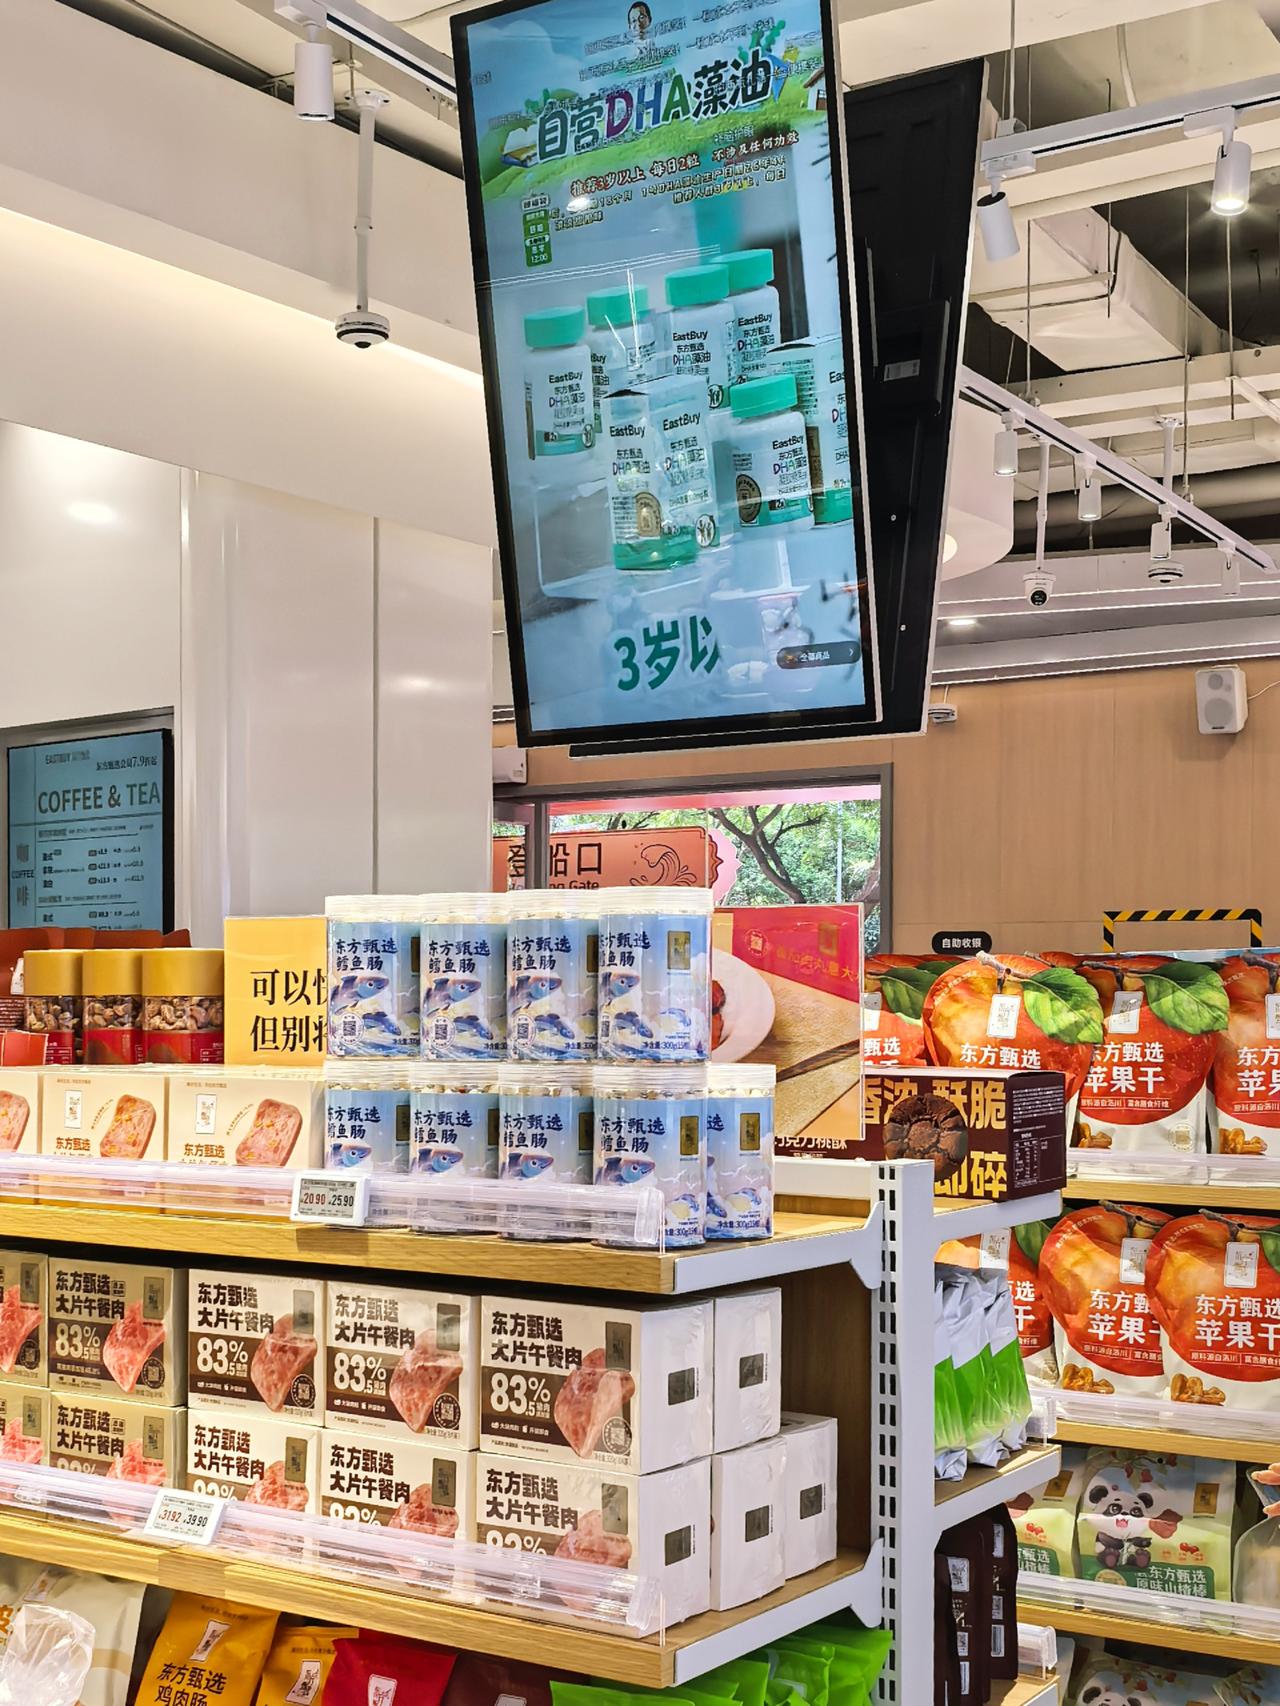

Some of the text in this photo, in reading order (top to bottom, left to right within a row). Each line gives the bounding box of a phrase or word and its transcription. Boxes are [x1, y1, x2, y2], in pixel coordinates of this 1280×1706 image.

[672, 330, 708, 342] EastBuy
[610, 424, 646, 438] EastBuy
[38, 780, 161, 815] COFFEE & TEA
[428, 939, 491, 957] 东方甄选
[942, 937, 982, 949] 自助收银
[959, 1042, 1041, 1070] 东方甄选
[414, 1109, 473, 1128] 东方甄选
[503, 1112, 564, 1131] 东方甄选
[600, 1115, 666, 1136] 东方甄选
[55, 1136, 91, 1152] 东方甄选
[183, 1143, 225, 1159] 东方甄选
[600, 1134, 649, 1154] 鳕鱼肠
[56, 1270, 110, 1296] 东方甄选
[198, 1282, 258, 1309] 东方甄选
[55, 1294, 125, 1320] 大片午餐肉
[335, 1293, 399, 1323] 东方甄选
[1195, 1293, 1280, 1320] 东方甄选
[198, 1307, 274, 1334] 大片午餐肉
[491, 1310, 563, 1342] 东方甄选
[334, 1321, 415, 1351] 大片午餐肉
[1194, 1319, 1280, 1352] 苹果干
[491, 1339, 583, 1371] 大片午餐肉
[57, 1404, 111, 1433] 东方甄选
[57, 1428, 125, 1458] 大片午餐肉
[194, 1424, 251, 1454] 东方甄选
[194, 1449, 265, 1481] 大片午餐肉
[330, 1444, 394, 1476] 东方甄选
[329, 1471, 411, 1503] 大片午餐肉
[486, 1468, 559, 1502] 东方甄选
[485, 1496, 579, 1532] 大片午餐肉
[1149, 1564, 1207, 1584] 东方甄选
[156, 1662, 227, 1695] 东方甄选
